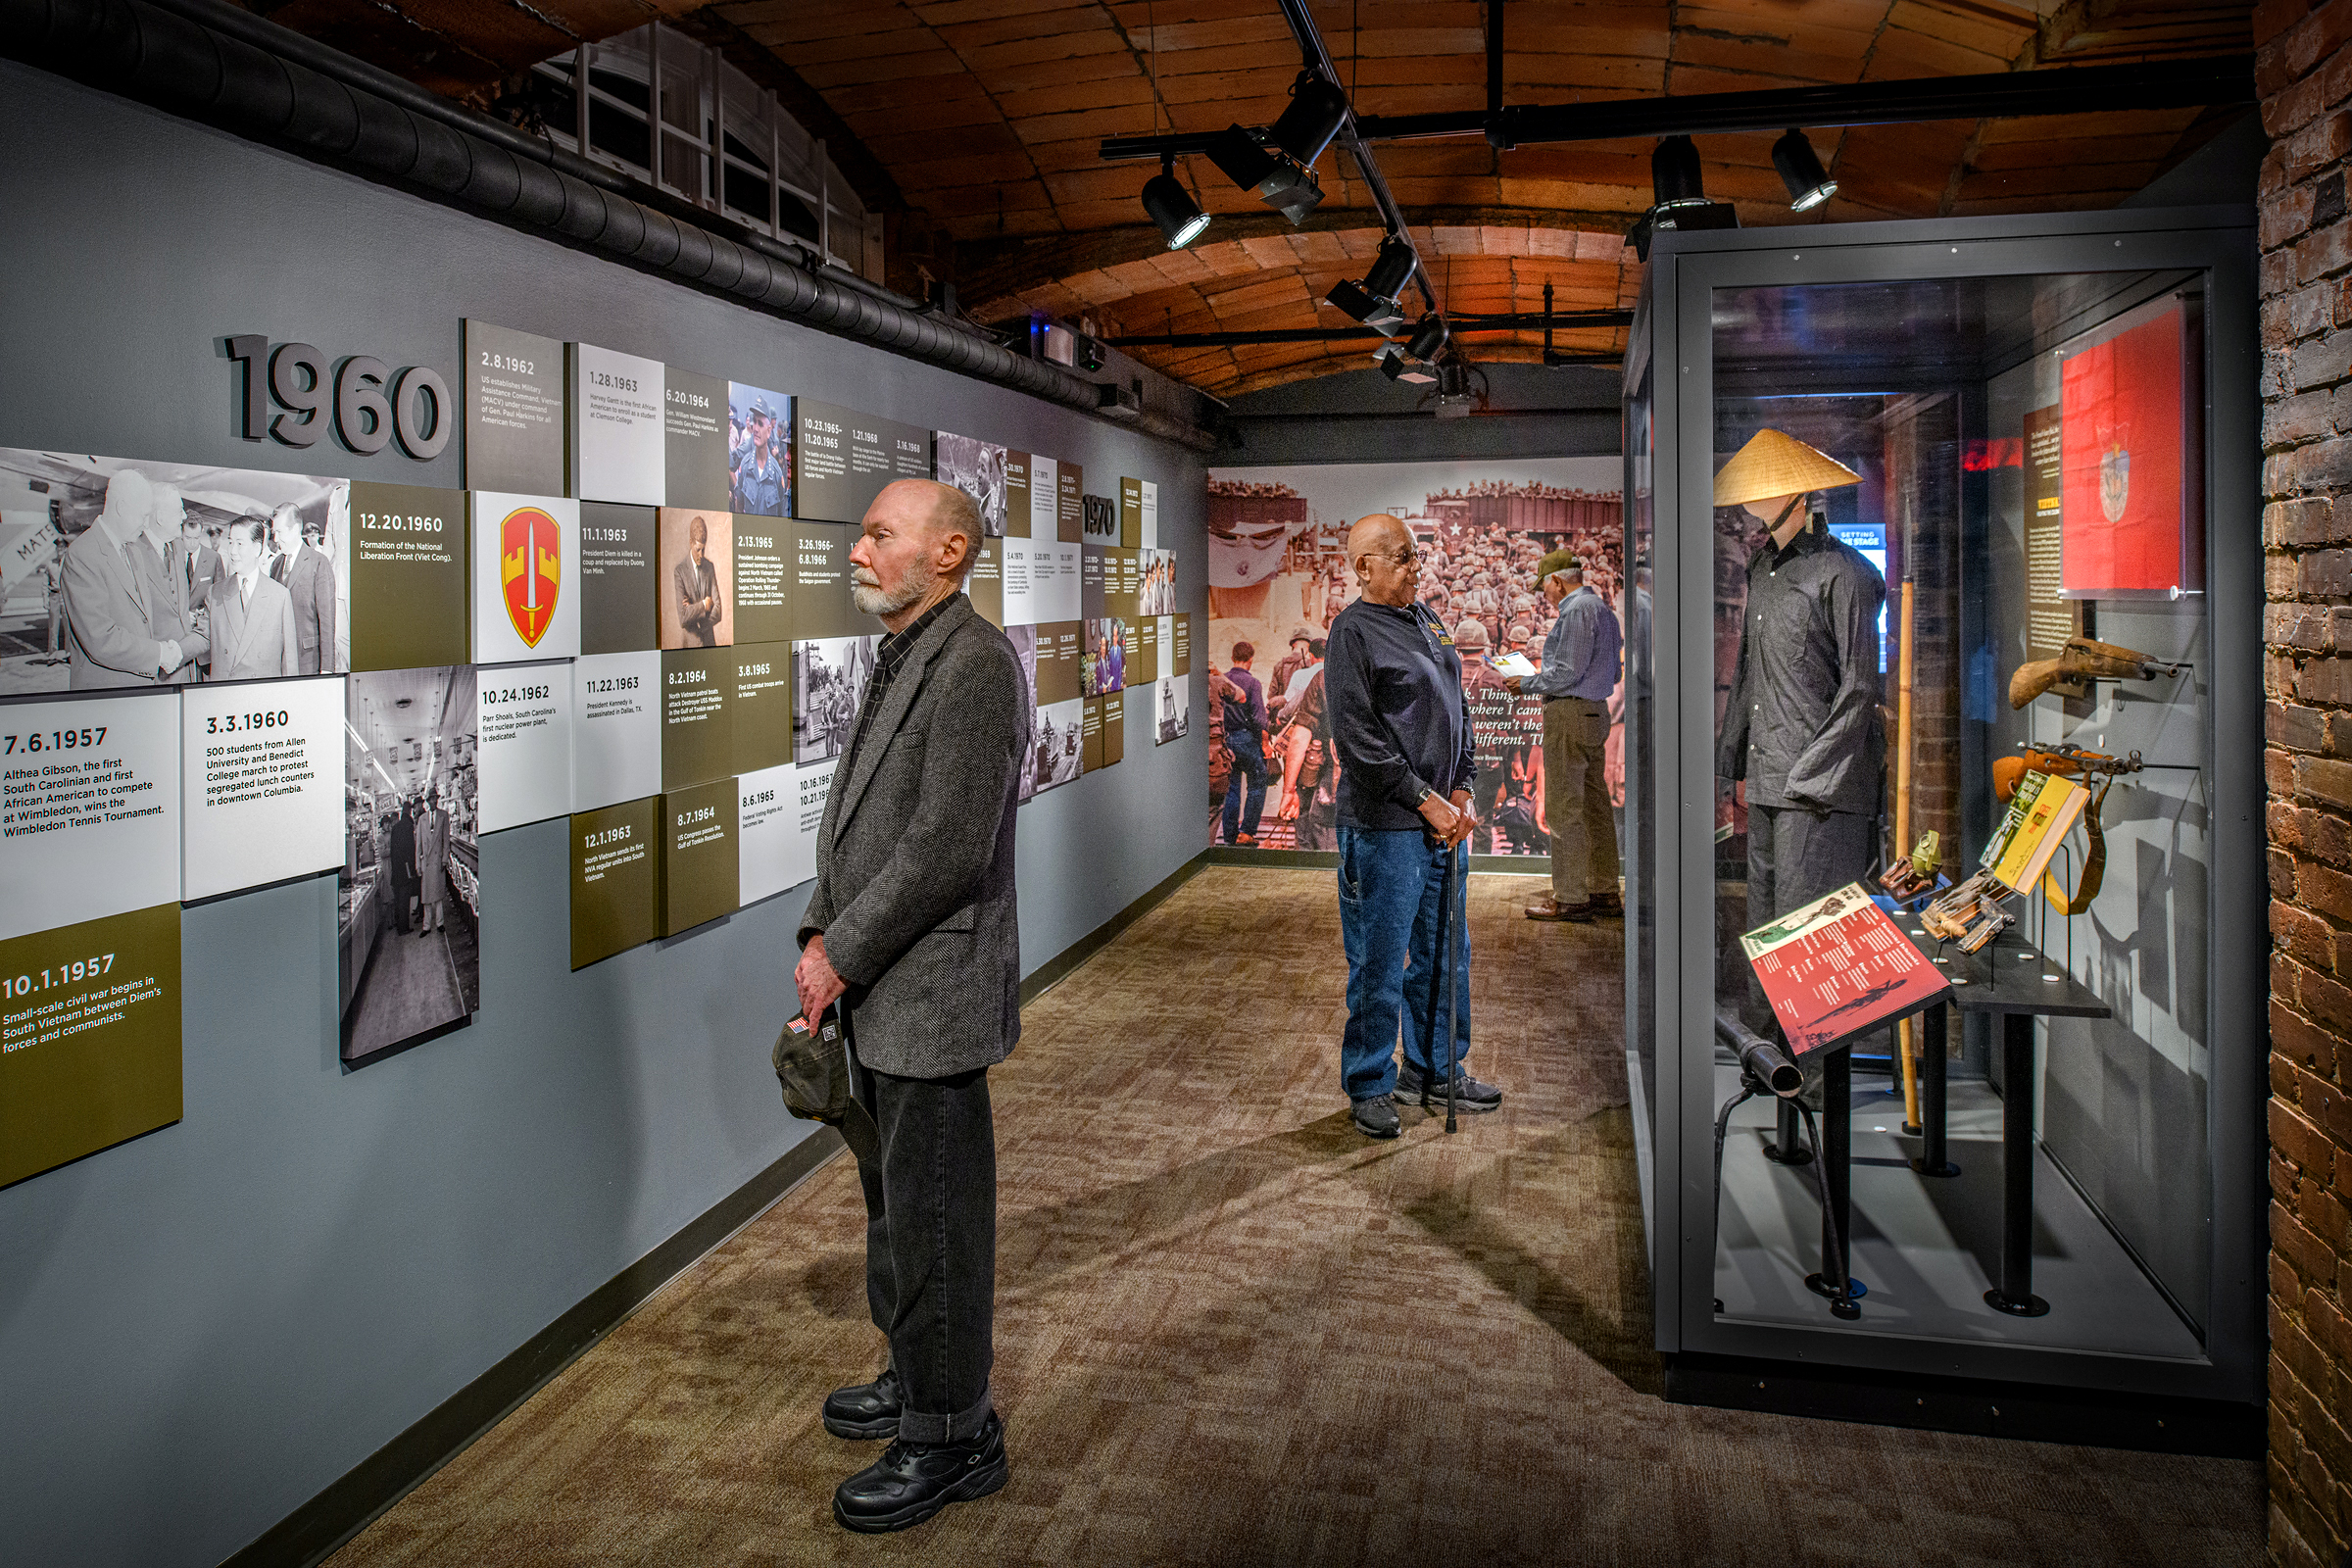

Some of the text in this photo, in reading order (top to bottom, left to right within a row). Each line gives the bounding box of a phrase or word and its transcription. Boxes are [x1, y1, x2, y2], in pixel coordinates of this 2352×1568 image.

[482, 352, 534, 374] 2.8.1962
[491, 379, 520, 389] establishes
[522, 383, 541, 394] Military
[590, 371, 637, 392] 1.28.1963
[223, 335, 452, 460] 1960
[482, 386, 562, 406] Assistance Command, Vietnam
[482, 397, 503, 408] (MACV)
[590, 394, 606, 404] Harvey
[666, 390, 709, 408] 6.20.1964
[516, 412, 535, 420] Harkins
[590, 404, 612, 413] American
[482, 416, 508, 425] American
[596, 413, 614, 421] Clemson
[616, 416, 633, 425] College.
[805, 418, 843, 434] 10.23.1965-
[805, 433, 838, 449] 11.20.1965
[853, 430, 878, 443] 1.21.1968
[897, 440, 920, 453] 3.16.1968
[360, 514, 443, 532] 12.20.1960
[1083, 494, 1115, 536] 1970
[583, 528, 627, 541] 11.1.1963
[738, 536, 773, 548] 2.13.1965
[360, 552, 394, 561] Liberation
[416, 554, 429, 563] (Viet
[432, 554, 453, 563] Cong).
[799, 555, 827, 564] 6.8.1966
[669, 670, 707, 684] 8.2.1964
[739, 663, 770, 677] 3.8.1965
[587, 677, 639, 693] 11.22.1963
[483, 686, 549, 705] 10.24.1962
[532, 708, 556, 716] Carolina's
[1469, 703, 1514, 714] where I
[207, 710, 288, 734] 3.3.1960
[1475, 718, 1520, 730] weren't
[4, 727, 108, 755] 7.6.1957
[489, 732, 516, 741] dedicated.
[207, 738, 306, 757] 500 students from Allen
[207, 750, 304, 769] University and Benedict
[3, 760, 122, 780] Althea Gibson, the first
[207, 771, 239, 782] College
[242, 765, 267, 777] march
[280, 761, 308, 774] protest
[3, 771, 133, 795] South Carolinian and first
[207, 773, 315, 795] segregated lunch counters
[3, 797, 42, 809] African
[46, 790, 94, 804] American
[111, 782, 153, 794] compete
[207, 786, 304, 807] in downtown Columbia.
[743, 791, 774, 807] 8.6.1965
[3, 798, 125, 823] at Wimbledon, wins the
[678, 807, 714, 826] 8.7.1964
[3, 807, 165, 838] Wimbledon Tennis Tournament.
[585, 826, 631, 848] 12.1.1963
[3, 955, 115, 999] 10.1.1957
[3, 978, 154, 1024] Small-scale civil war begins in
[3, 989, 162, 1039] South Vietnam between Diem's
[3, 1014, 125, 1054] forces and communists.
